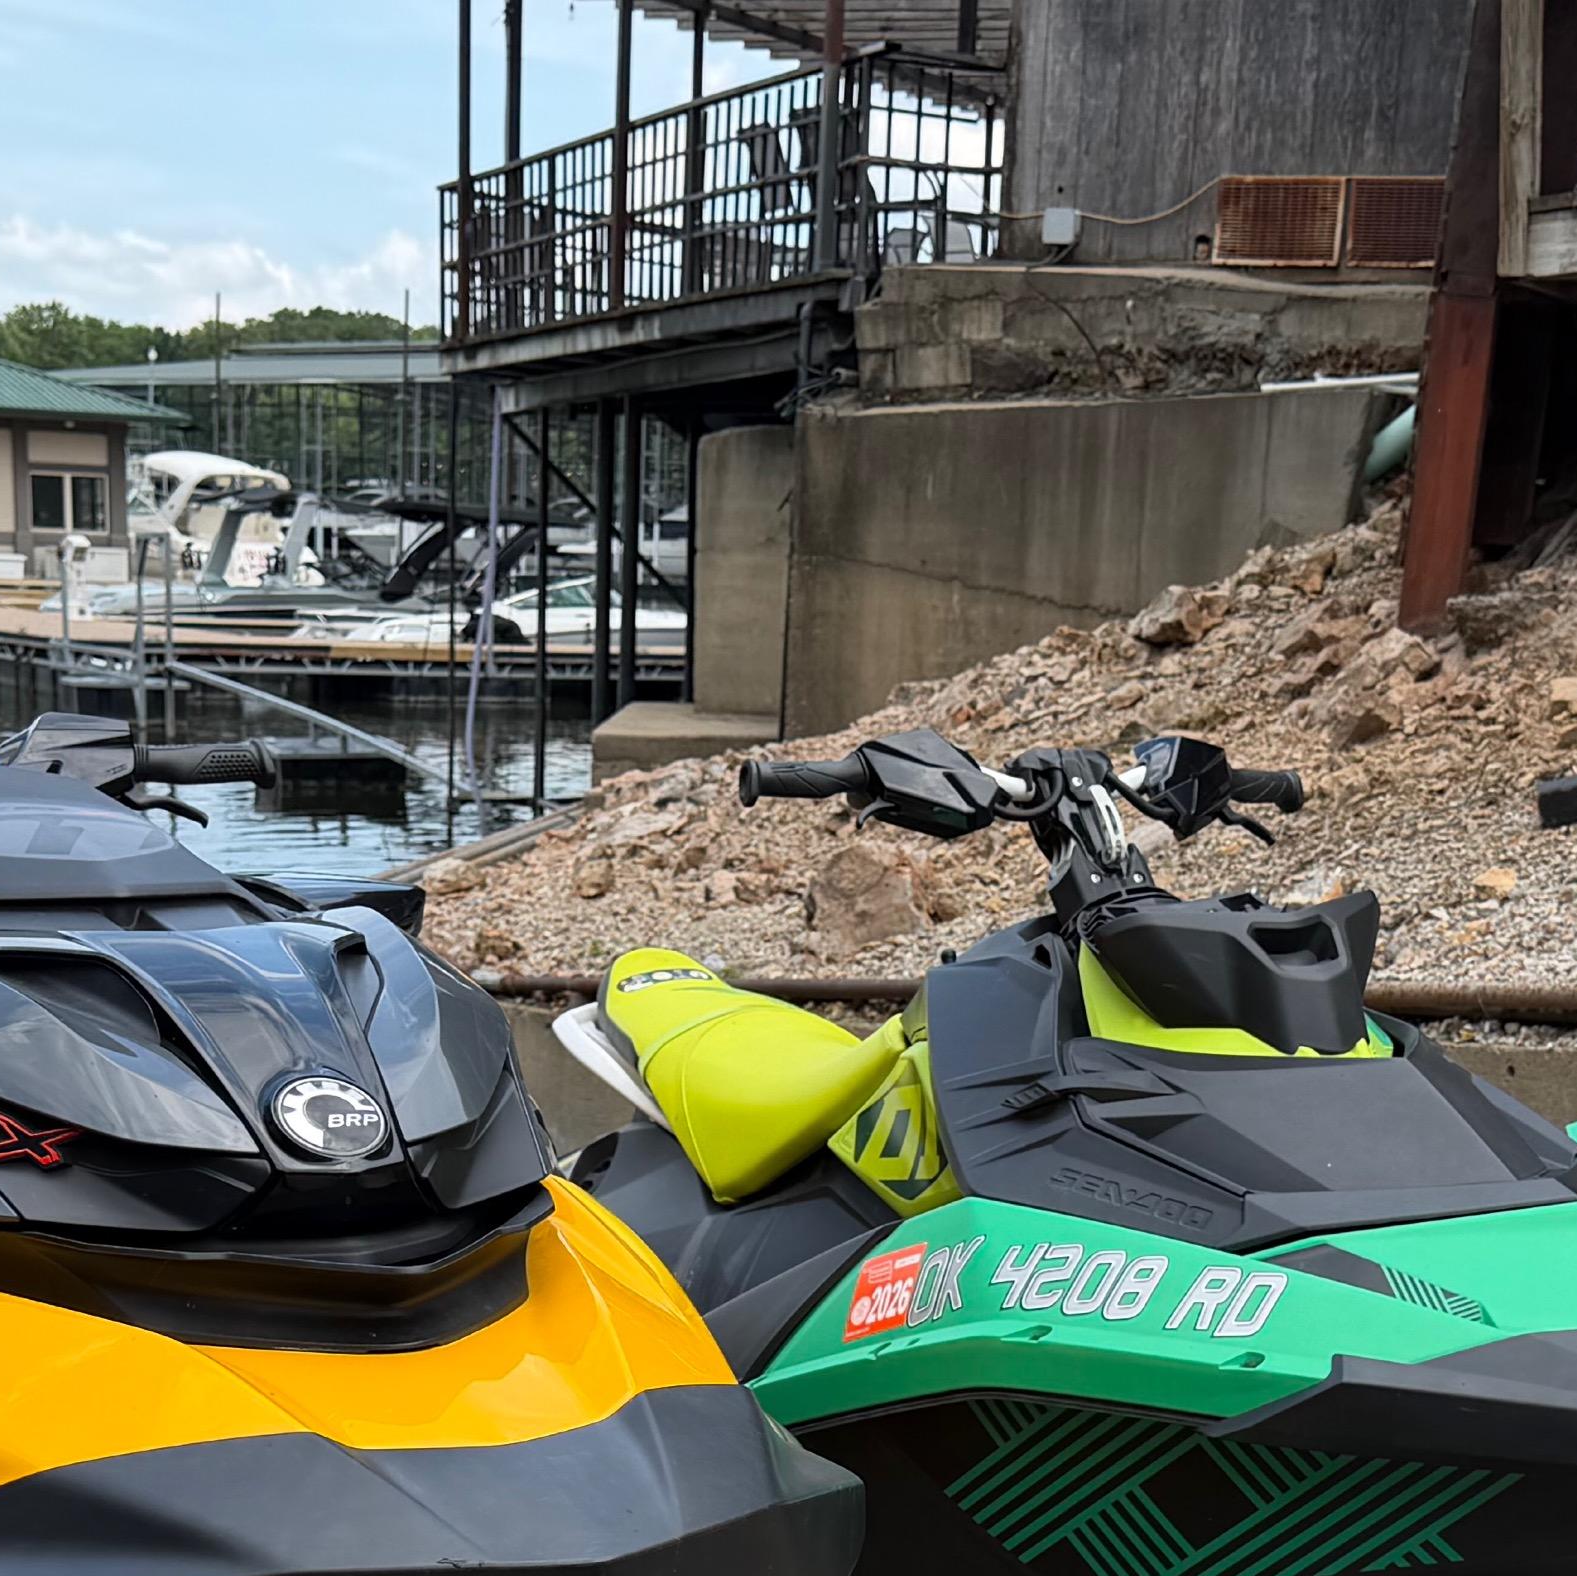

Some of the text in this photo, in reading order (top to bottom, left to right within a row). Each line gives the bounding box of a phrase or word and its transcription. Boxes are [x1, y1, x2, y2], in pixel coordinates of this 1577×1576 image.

[327, 1112, 379, 1129] BRP
[864, 1276, 915, 1325] 2026
[907, 1235, 1289, 1338] OK 4208 RD
